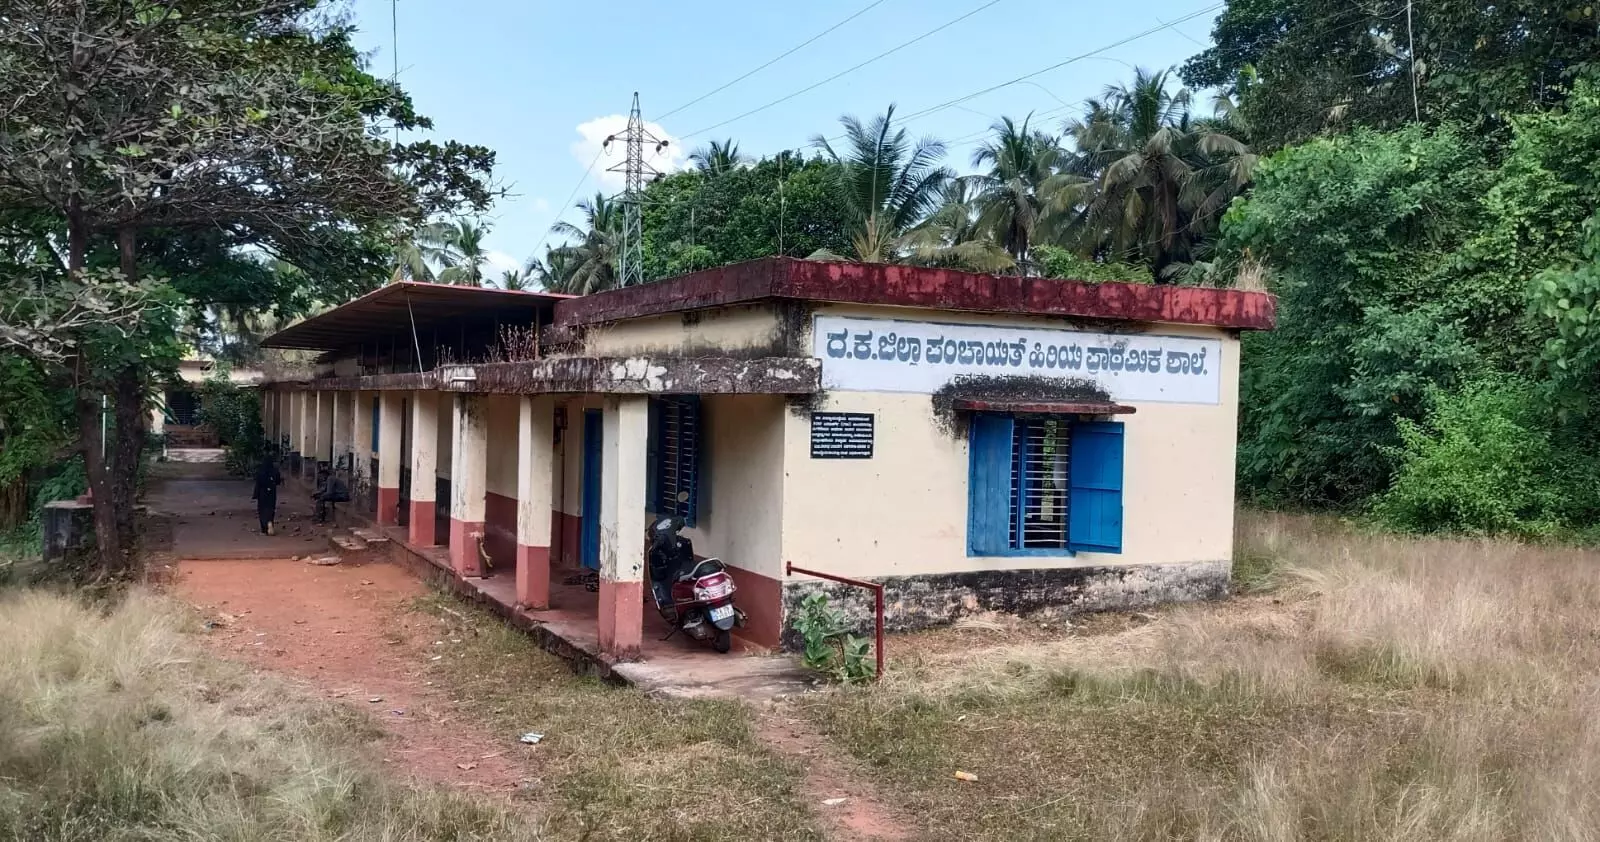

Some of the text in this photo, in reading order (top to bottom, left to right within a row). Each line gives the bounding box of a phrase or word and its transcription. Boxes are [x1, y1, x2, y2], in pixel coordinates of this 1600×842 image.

[926, 335, 1027, 367] ಪಂಚಾಯತ್
[1029, 342, 1082, 370] ಹಿರಿಯ
[1086, 346, 1163, 376] ಪ್ರಾಥಮಿಕ
